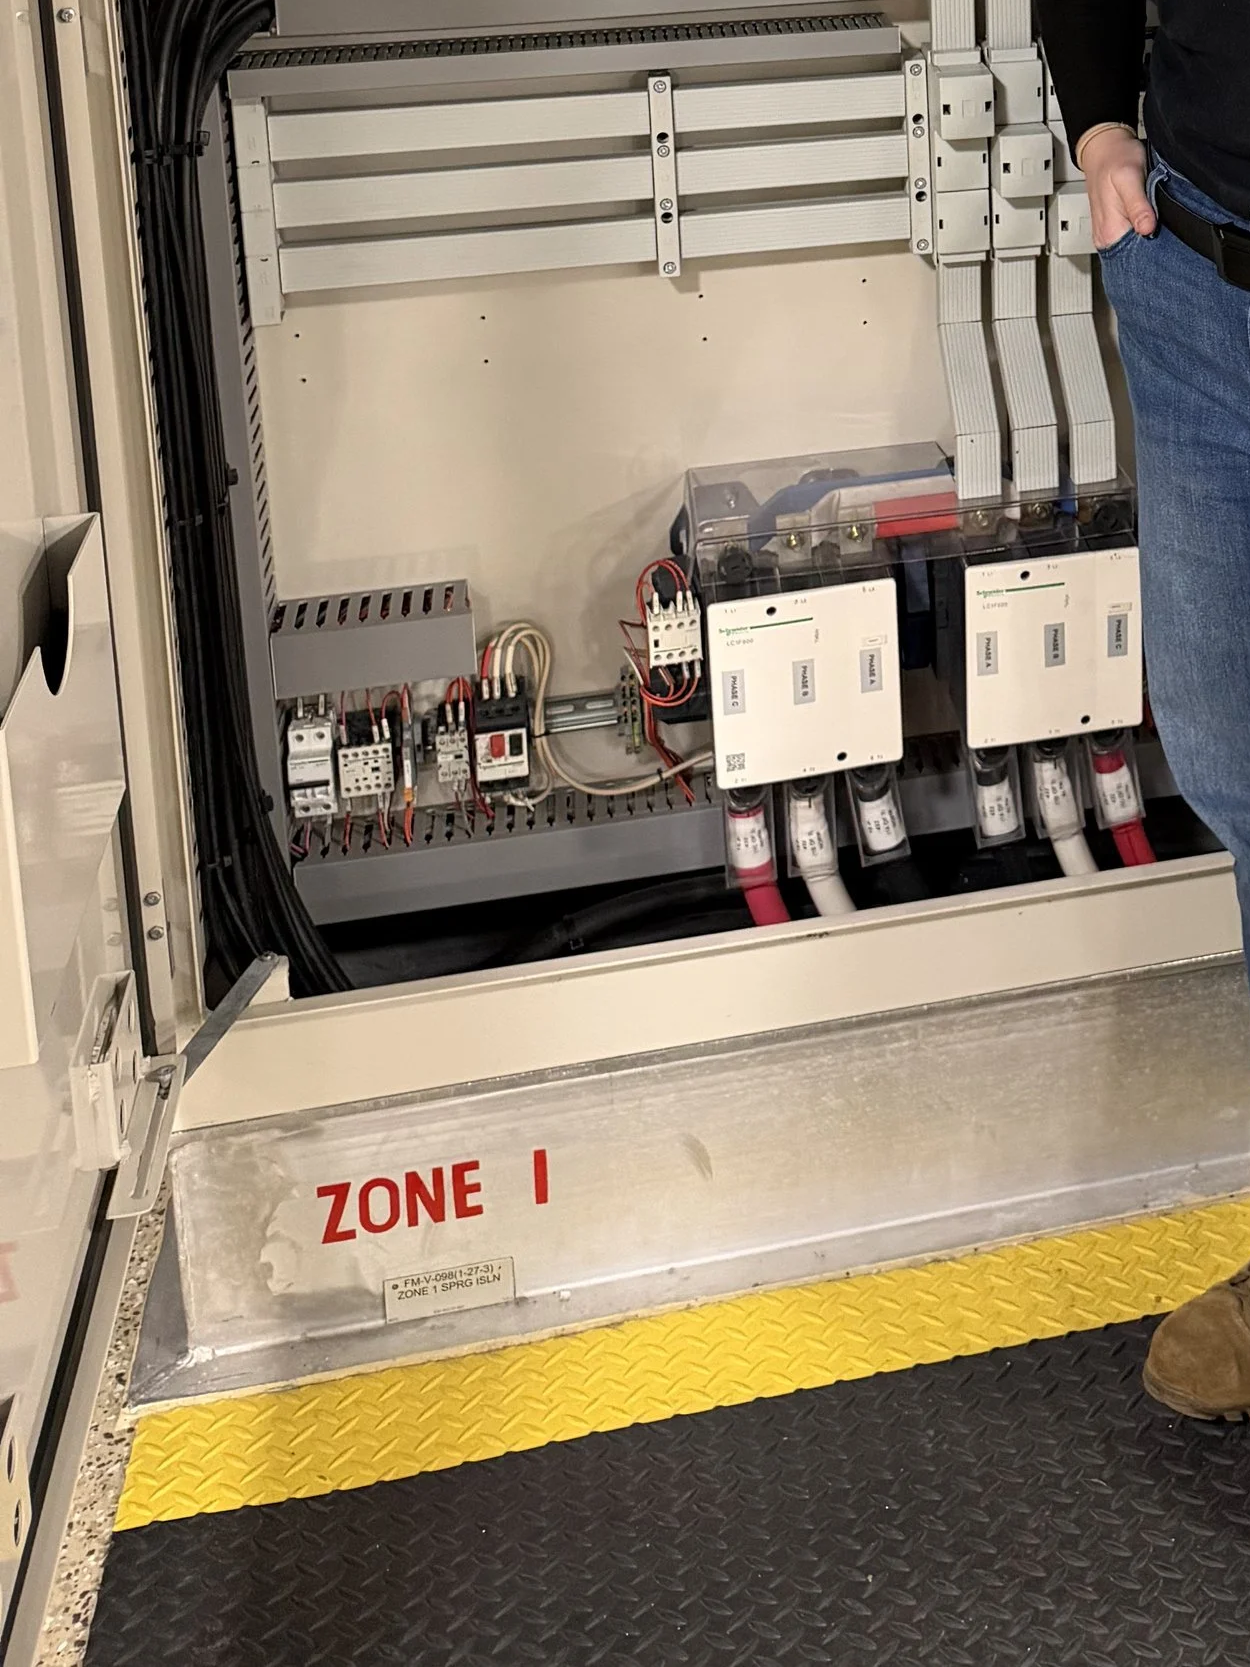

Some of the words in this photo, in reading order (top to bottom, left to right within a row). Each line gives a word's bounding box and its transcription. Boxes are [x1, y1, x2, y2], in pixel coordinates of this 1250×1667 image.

[801, 665, 809, 689] PHASE
[316, 1160, 484, 1244] ZONE
[397, 1286, 429, 1300] ZONE
[433, 1285, 438, 1294] 1
[441, 1278, 474, 1292] SPRG
[476, 1273, 501, 1286] ISLN
[404, 1264, 494, 1288] FM-V-098(1-27-3)
